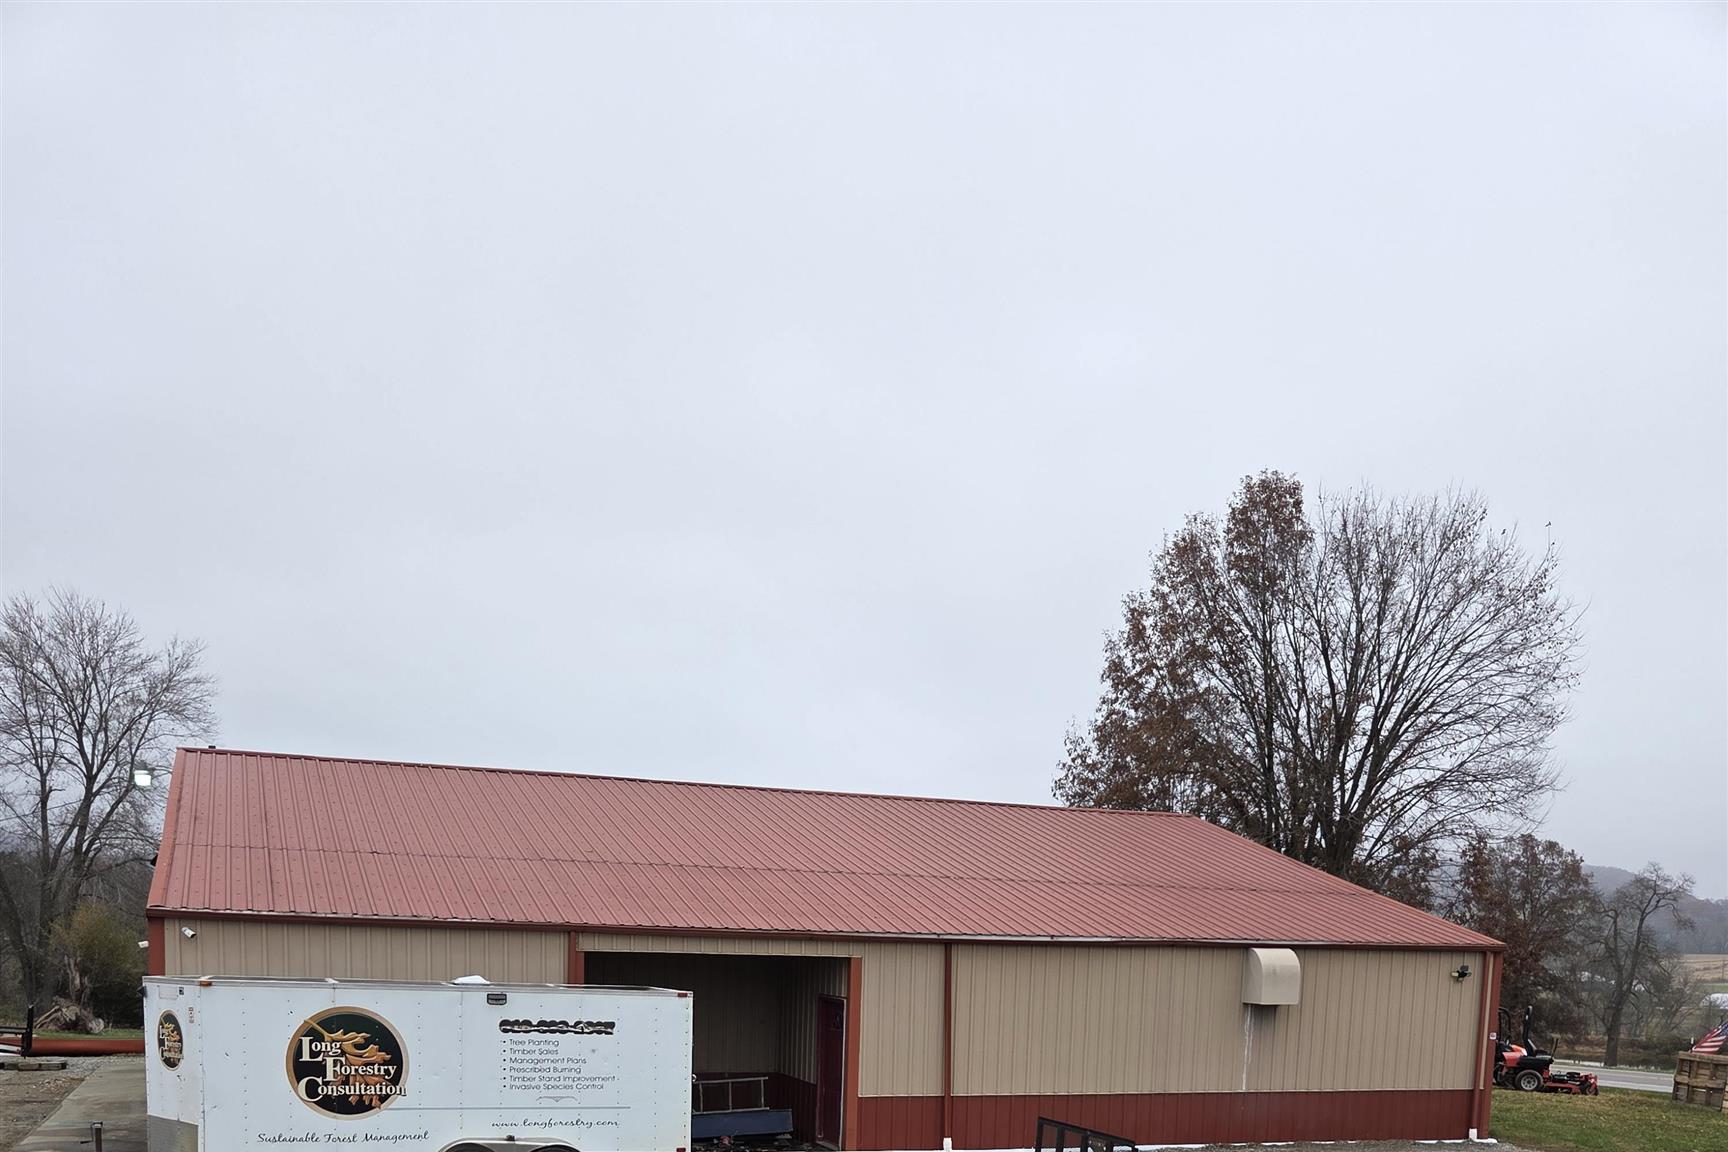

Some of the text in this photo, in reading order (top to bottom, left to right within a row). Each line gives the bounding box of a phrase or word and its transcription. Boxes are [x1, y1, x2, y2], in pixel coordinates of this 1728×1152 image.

[528, 1039, 559, 1048] Planting
[299, 1036, 342, 1062] Long
[509, 1057, 565, 1066] Management
[323, 1056, 397, 1081] Forestry
[553, 1066, 582, 1074] Burning
[563, 1075, 616, 1083] Improvement
[297, 1076, 407, 1102] Consultation
[543, 1083, 574, 1091] Species
[491, 1118, 619, 1130] www.longforestry.com
[257, 1131, 429, 1144] Sustainable Forest Management
